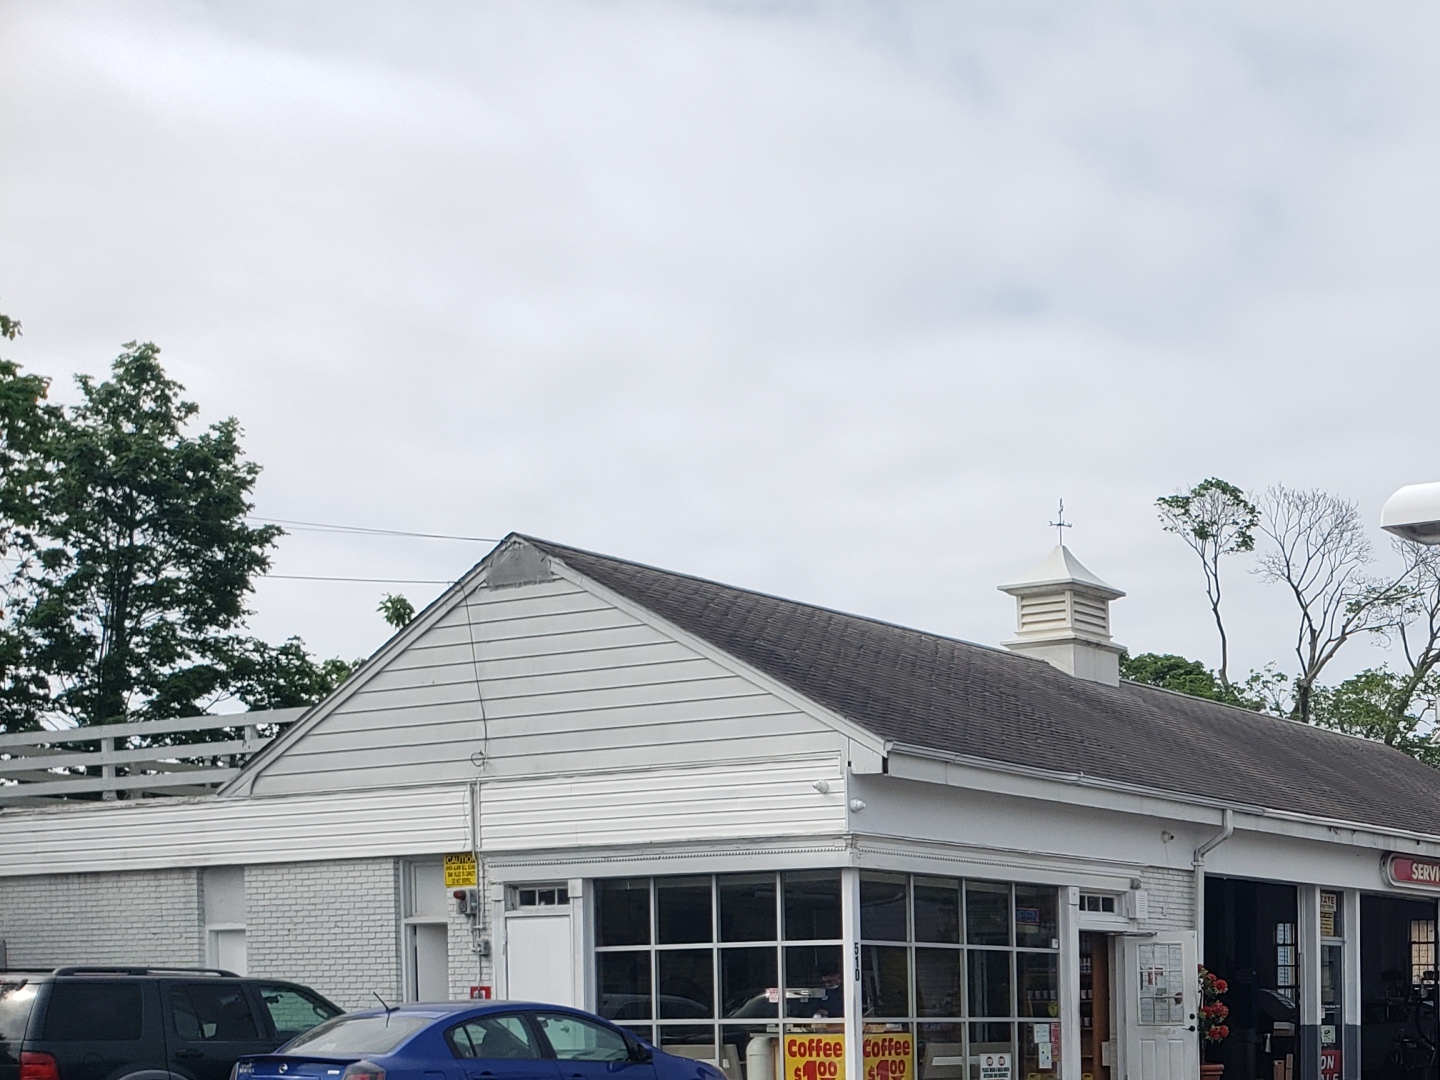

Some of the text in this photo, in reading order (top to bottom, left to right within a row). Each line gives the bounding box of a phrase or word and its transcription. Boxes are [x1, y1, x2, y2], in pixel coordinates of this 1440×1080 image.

[788, 1038, 843, 1058] Coffee
[863, 1038, 910, 1058] Coffee
[1320, 1055, 1335, 1070] ON
